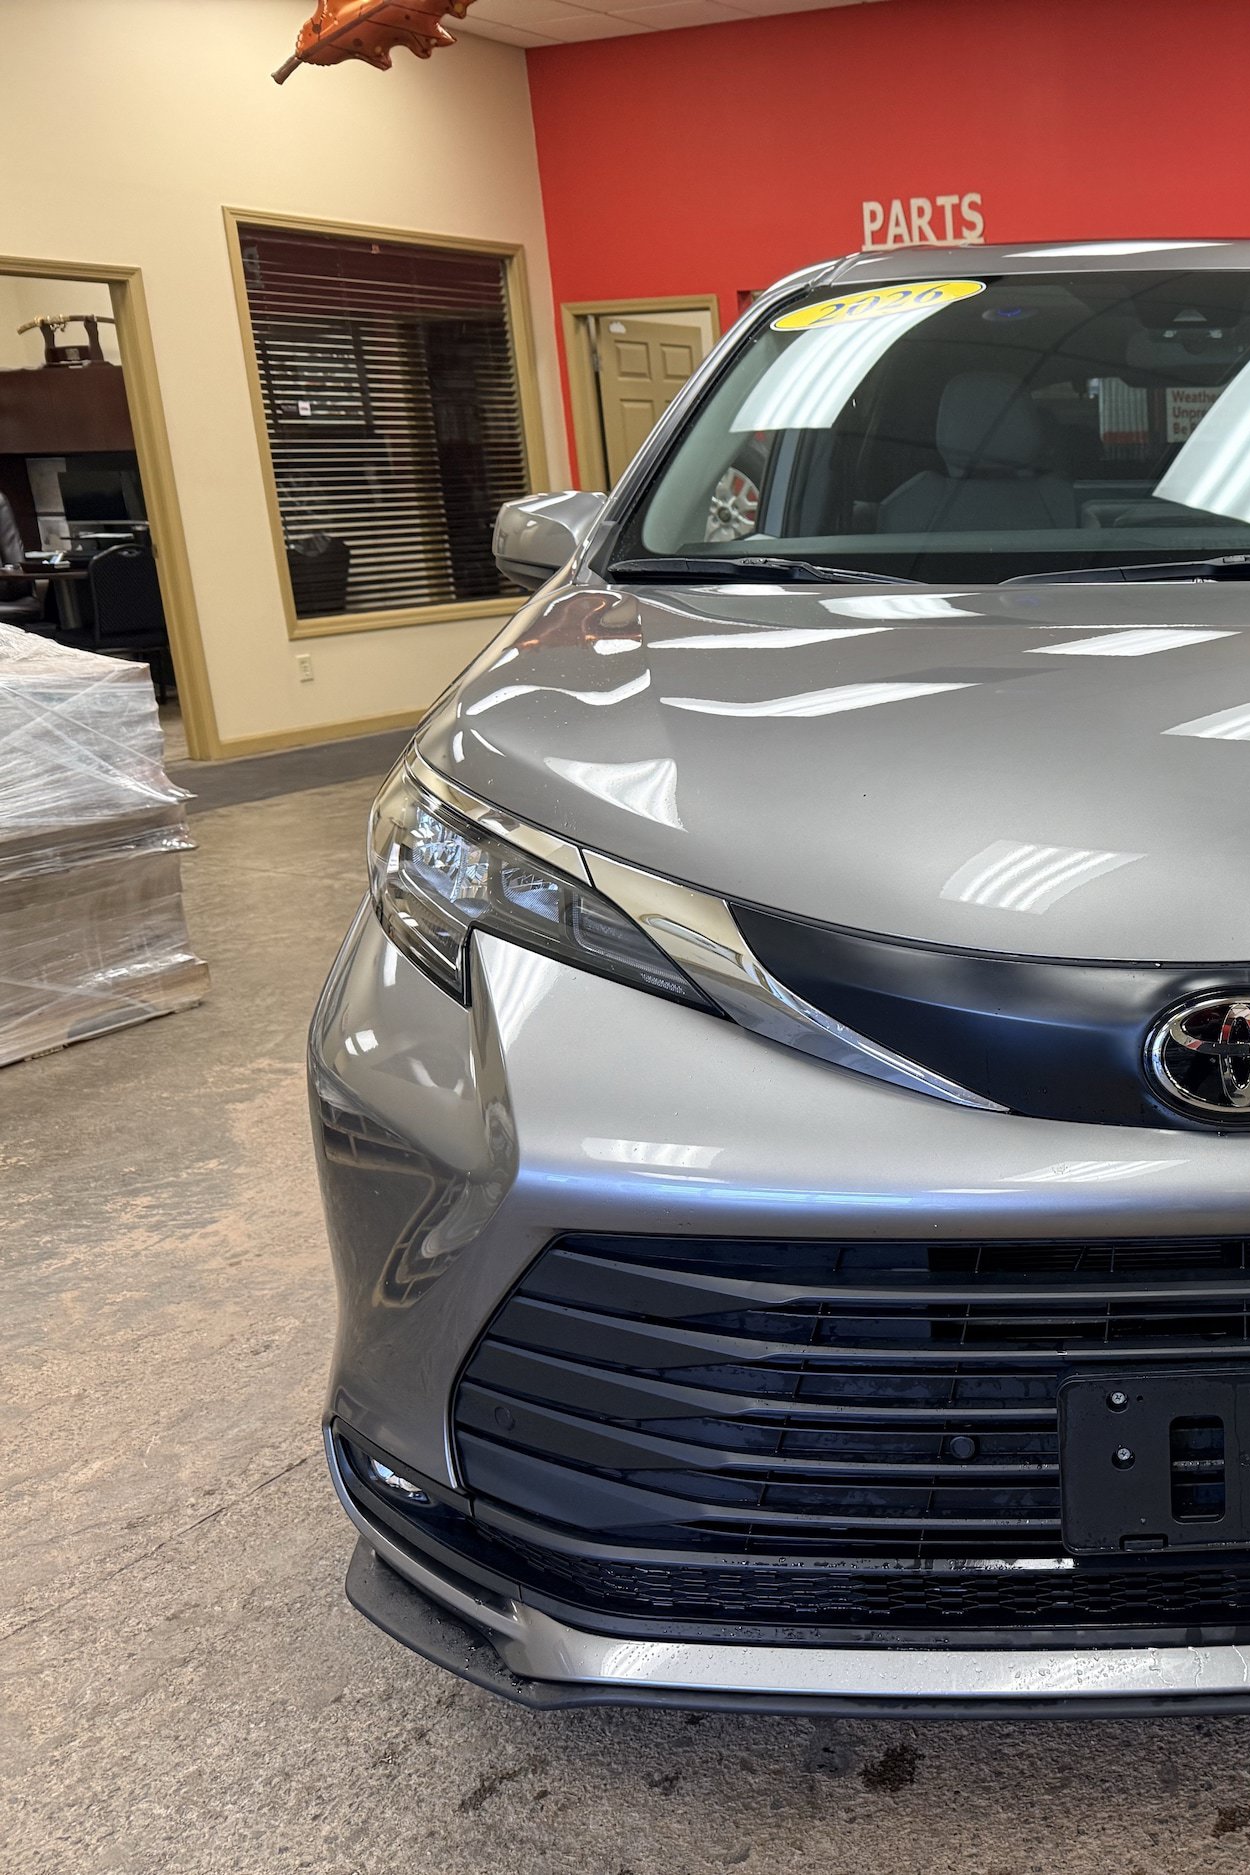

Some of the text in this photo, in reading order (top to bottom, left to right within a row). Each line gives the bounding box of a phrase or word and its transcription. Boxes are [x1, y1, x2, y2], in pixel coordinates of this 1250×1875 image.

[862, 192, 984, 245] PARTS
[808, 283, 951, 325] 2026
[1172, 390, 1217, 403] Weathe
